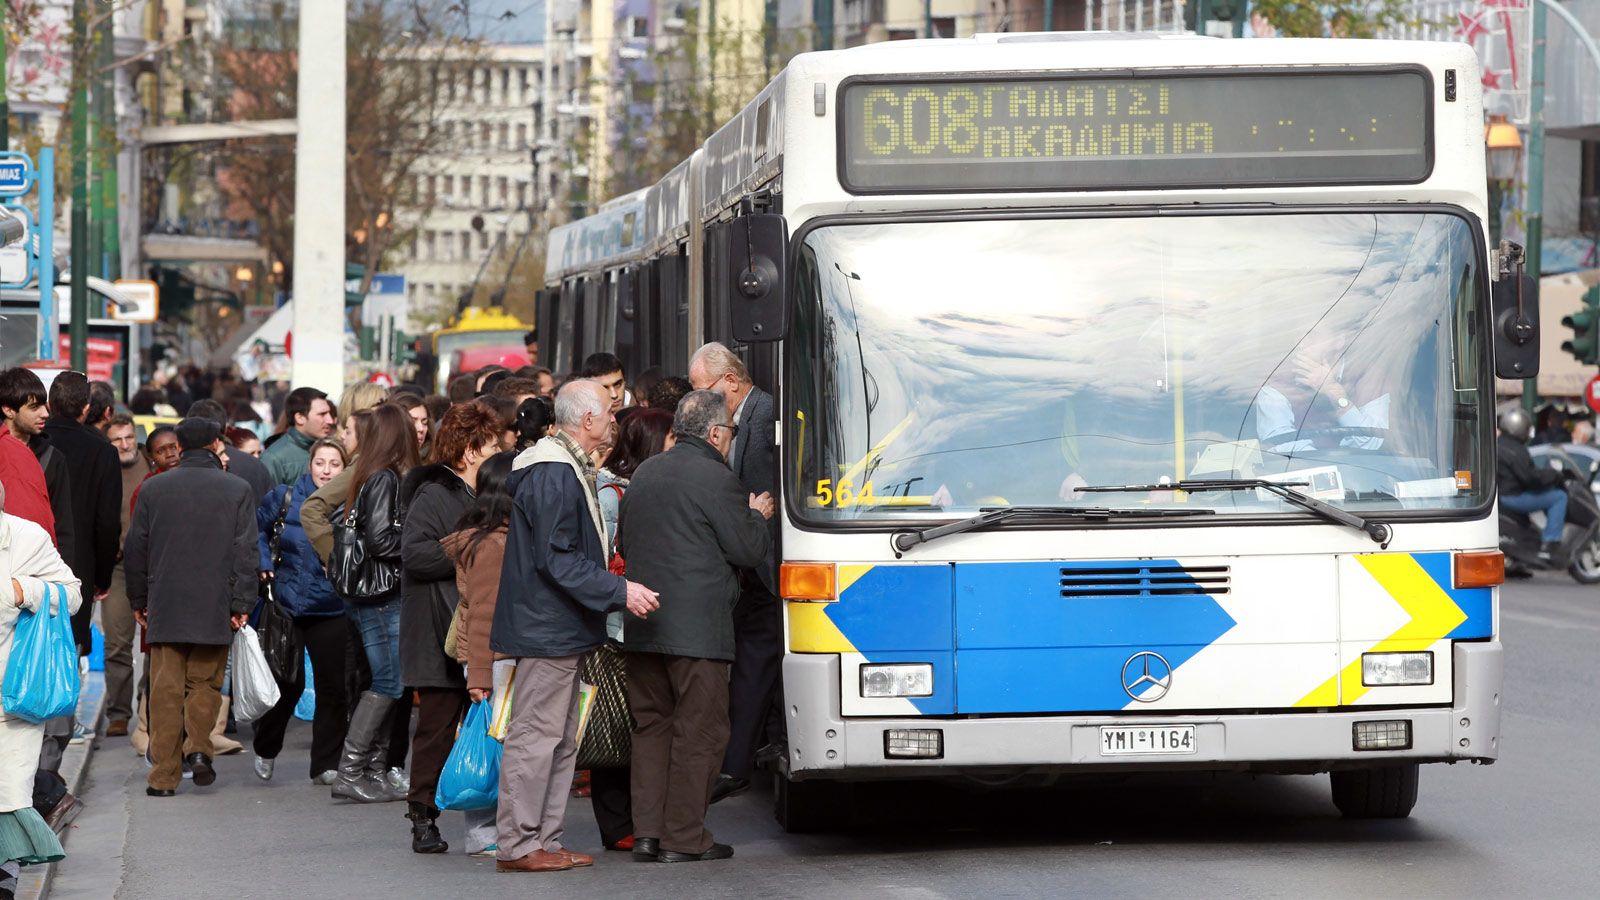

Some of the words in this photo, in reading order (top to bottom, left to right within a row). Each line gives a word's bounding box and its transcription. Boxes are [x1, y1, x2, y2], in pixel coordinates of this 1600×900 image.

[983, 84, 1169, 118] ΓΑΛΑΤΣΙ
[863, 87, 979, 155] 608
[983, 122, 1214, 157] ΑΚΑΔΗΜΙΑ
[816, 479, 876, 508] 564
